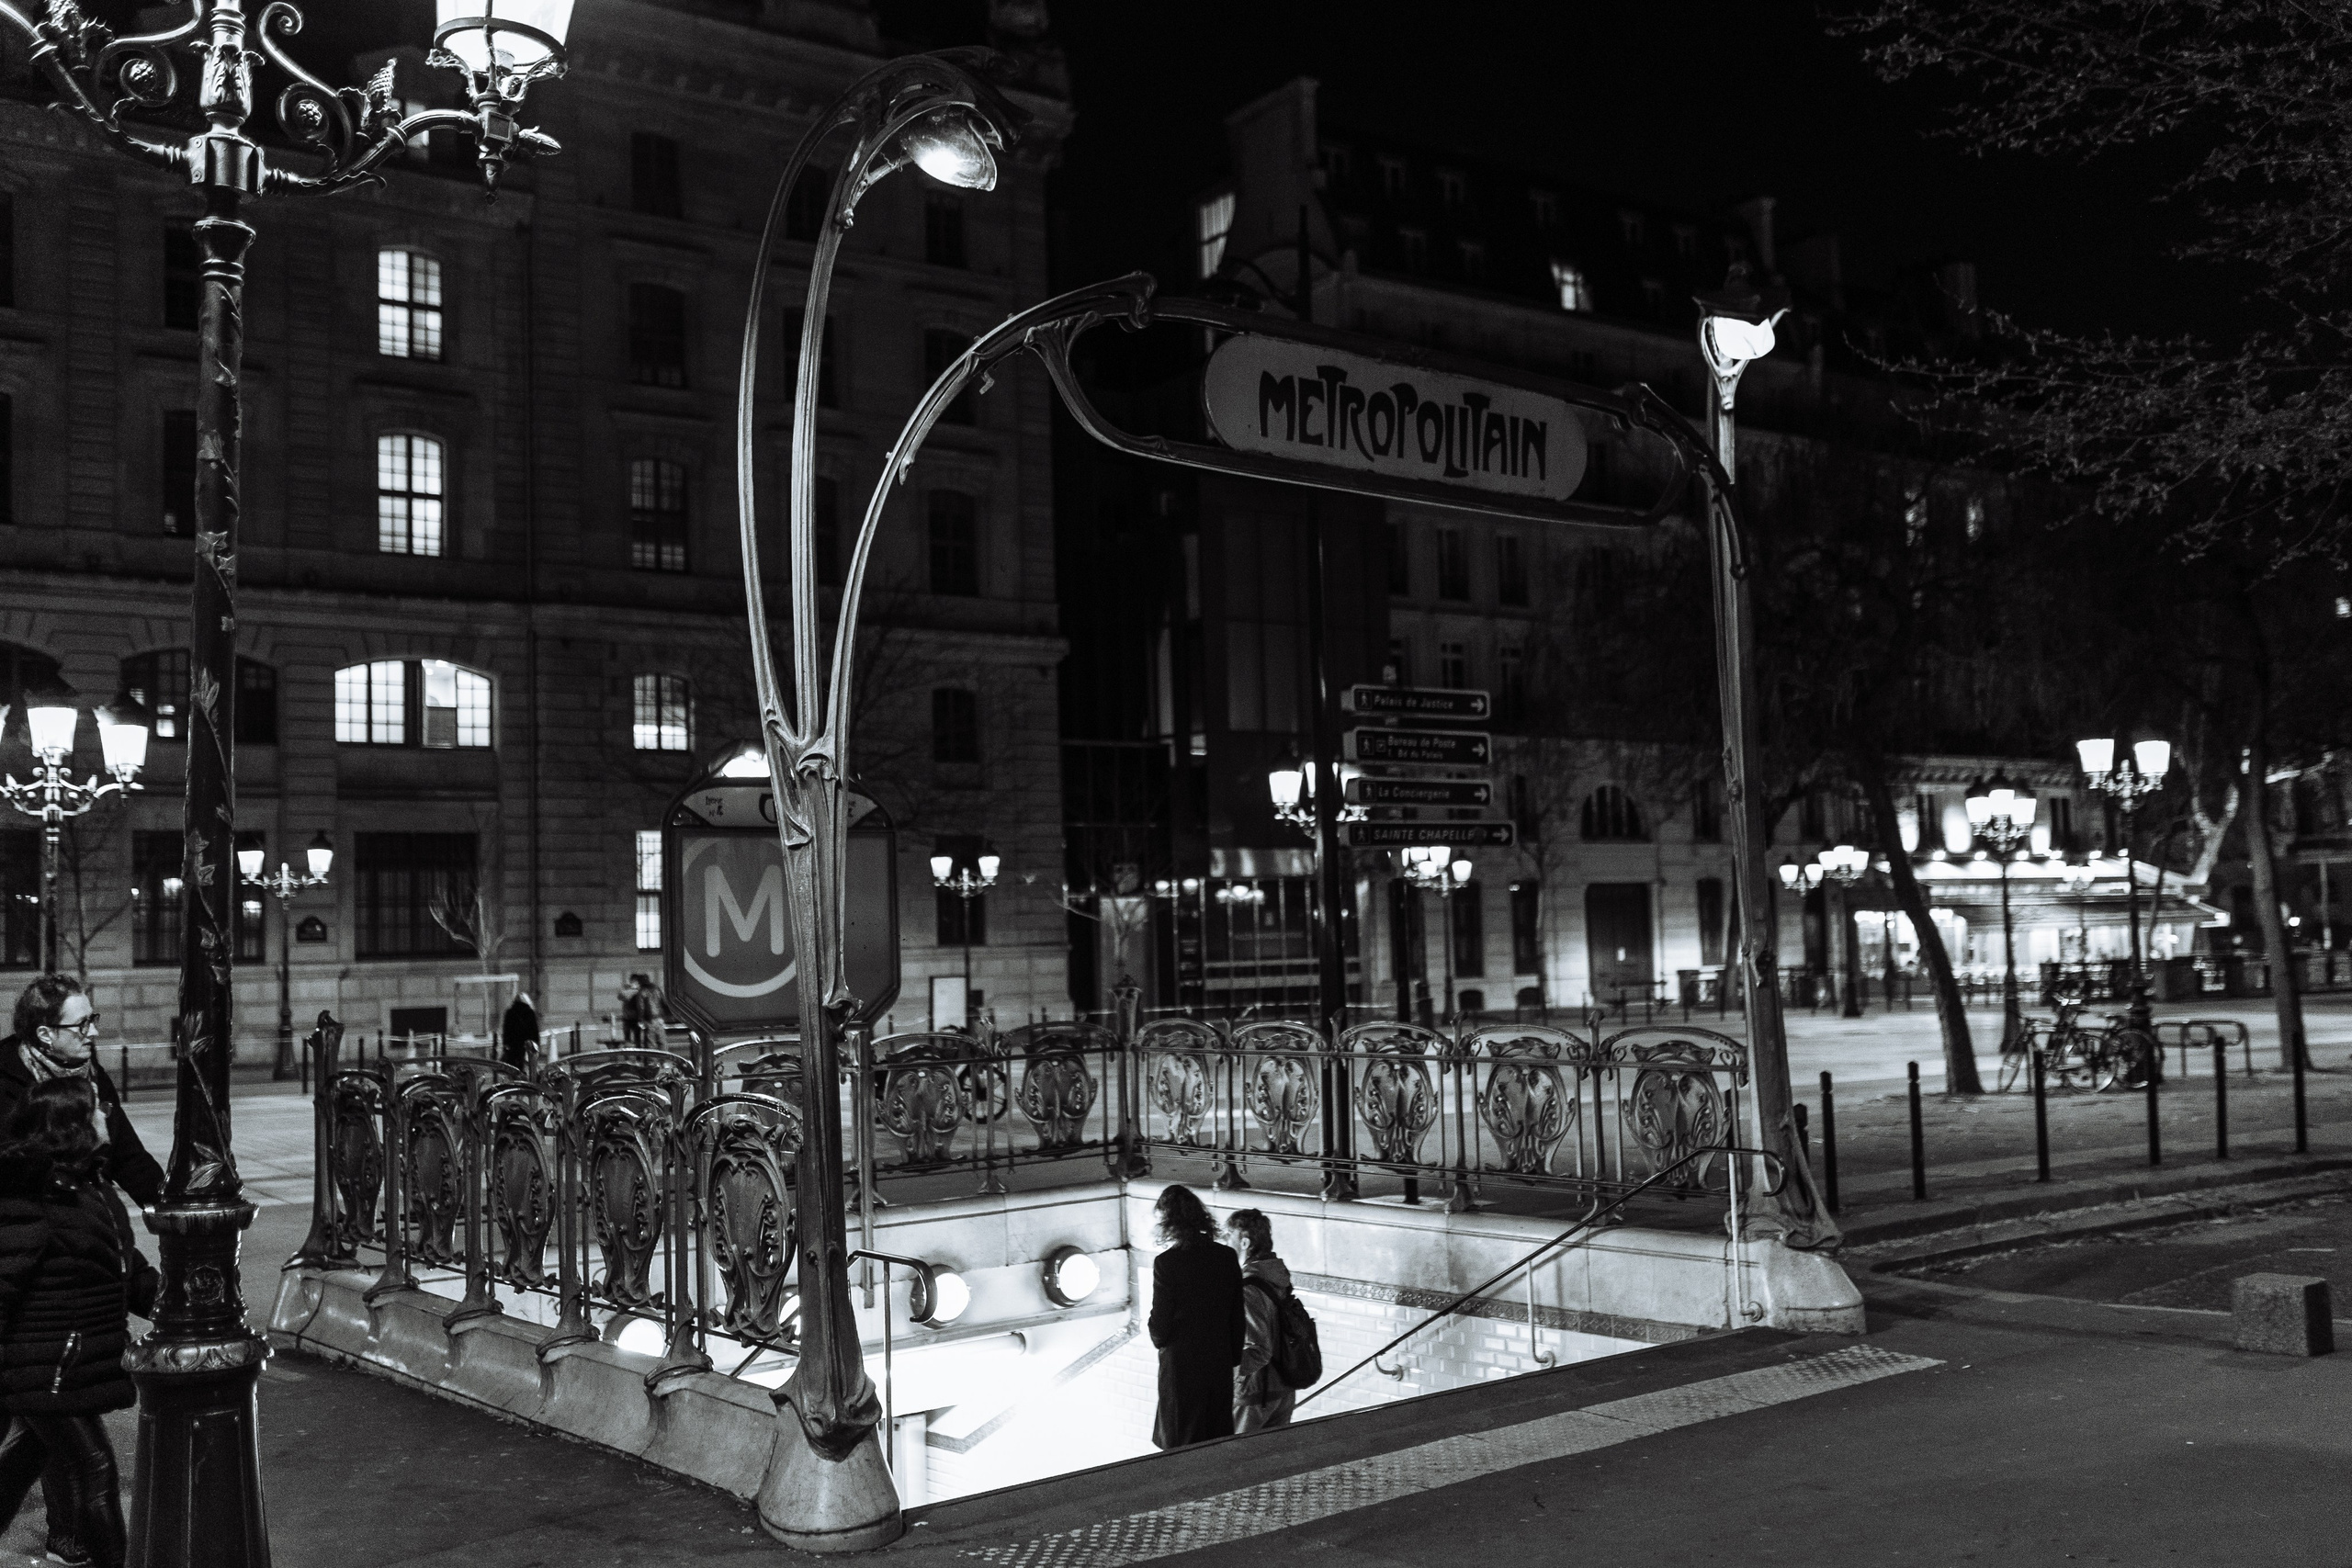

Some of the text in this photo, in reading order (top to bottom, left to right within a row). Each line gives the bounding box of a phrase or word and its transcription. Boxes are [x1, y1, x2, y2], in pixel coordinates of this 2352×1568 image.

[1259, 366, 1546, 480] METROPOLITAIN
[1374, 694, 1453, 709] Palais de Justice
[1388, 735, 1417, 747] Bureau
[1378, 786, 1450, 800] La Conciergerie
[1374, 829, 1415, 840] SAINTE
[705, 865, 784, 957] M
